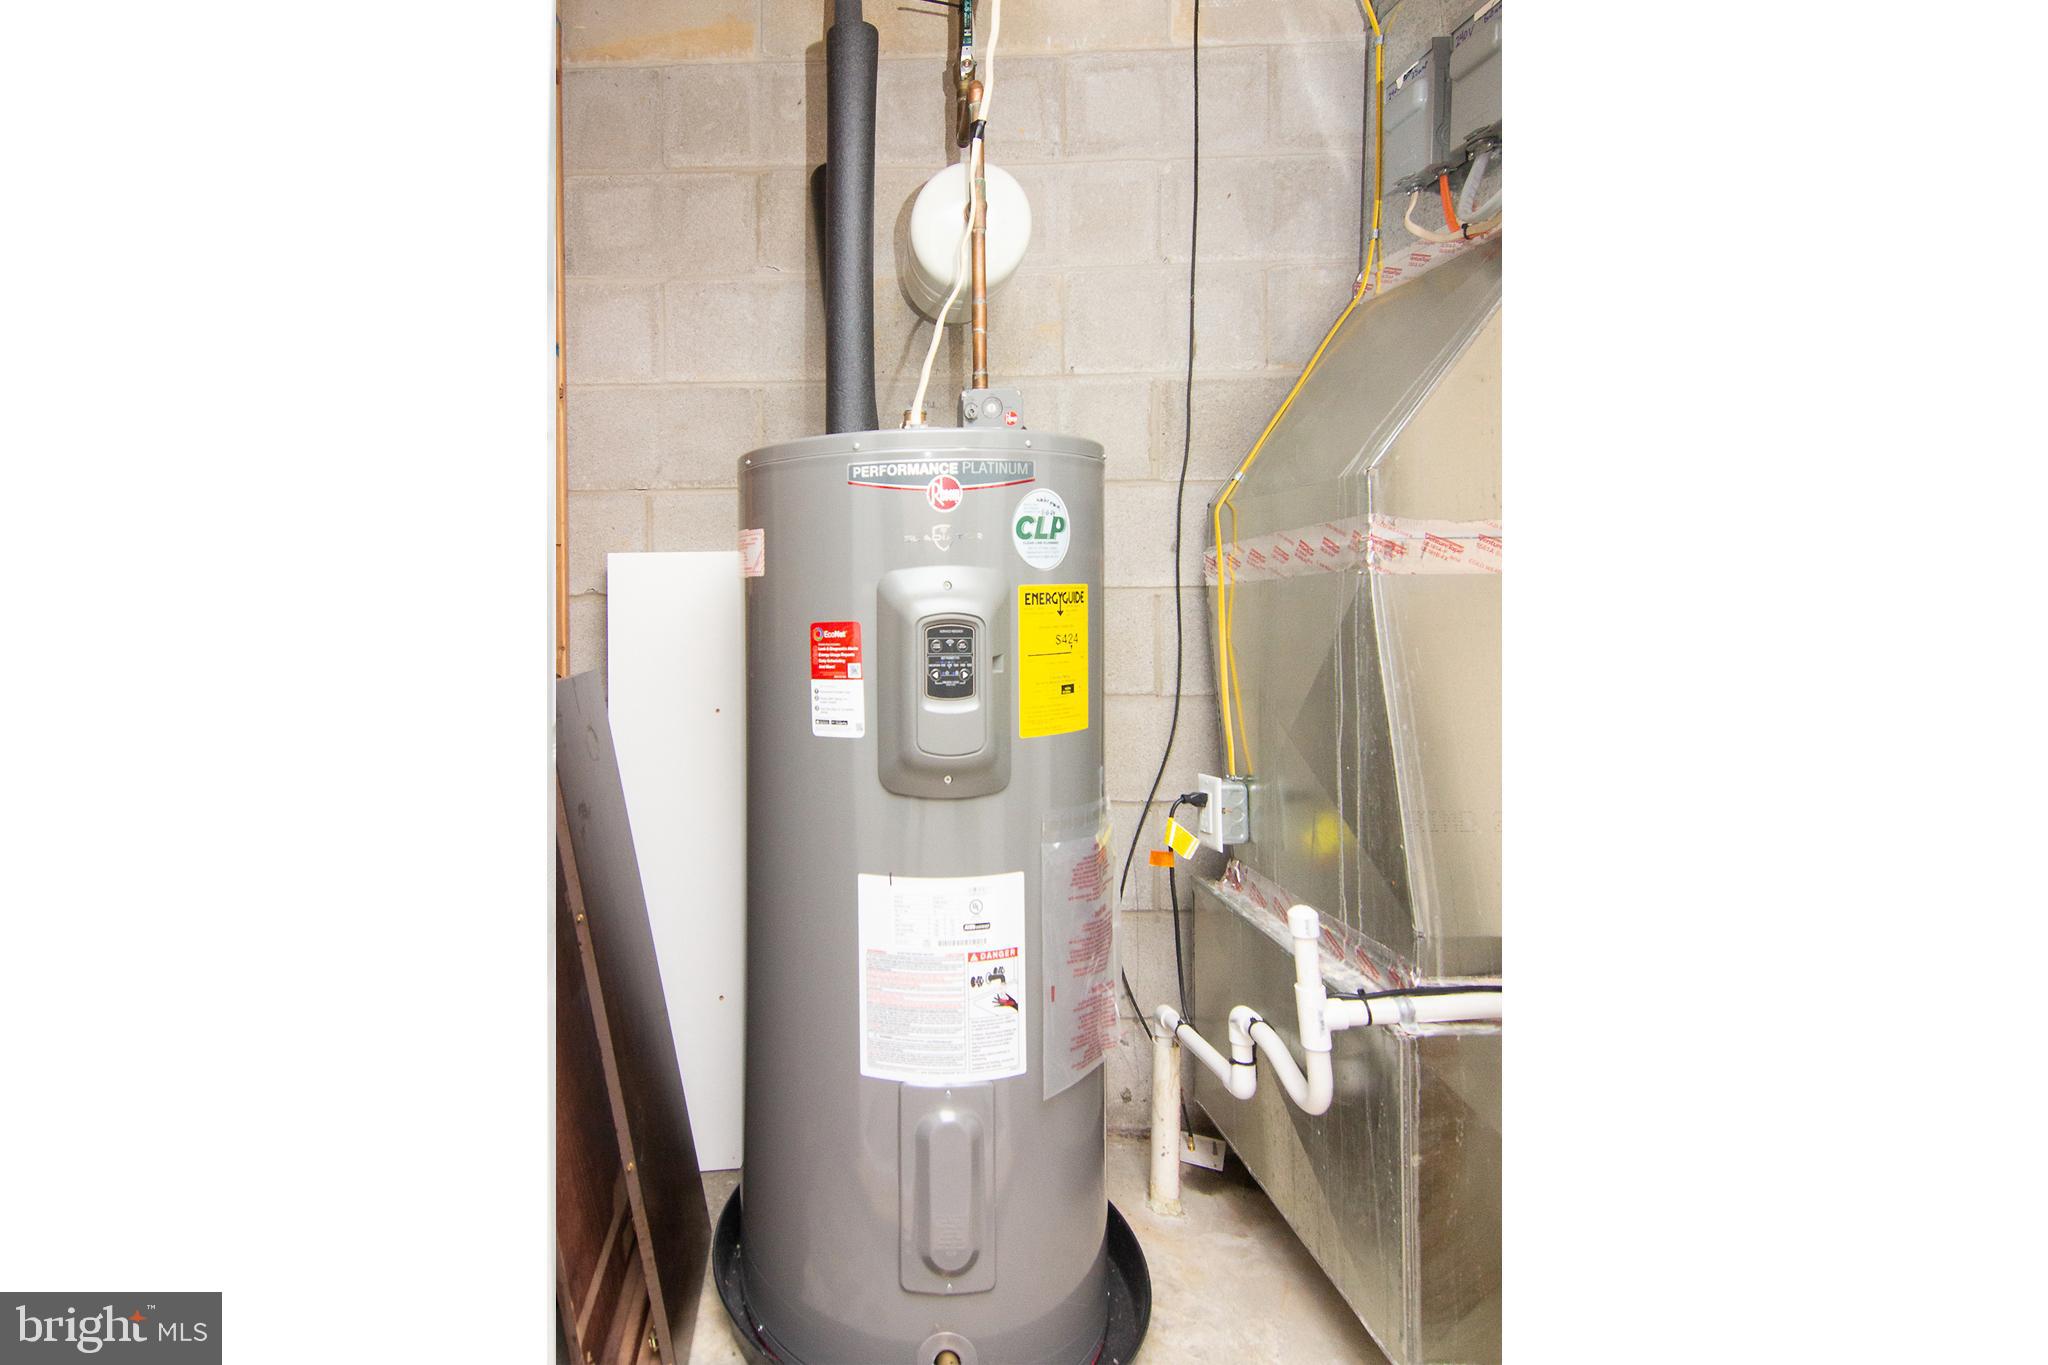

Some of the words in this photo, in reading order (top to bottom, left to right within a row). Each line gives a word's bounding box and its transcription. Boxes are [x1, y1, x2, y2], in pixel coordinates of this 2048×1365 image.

[852, 462, 958, 479] PERFORMANCE
[961, 461, 1028, 475] PLATINUM
[1015, 515, 1066, 540] CLP
[1024, 590, 1084, 606] ENERGYGUIDE
[823, 630, 847, 638] EcoNet
[980, 948, 1016, 960] DANGER
